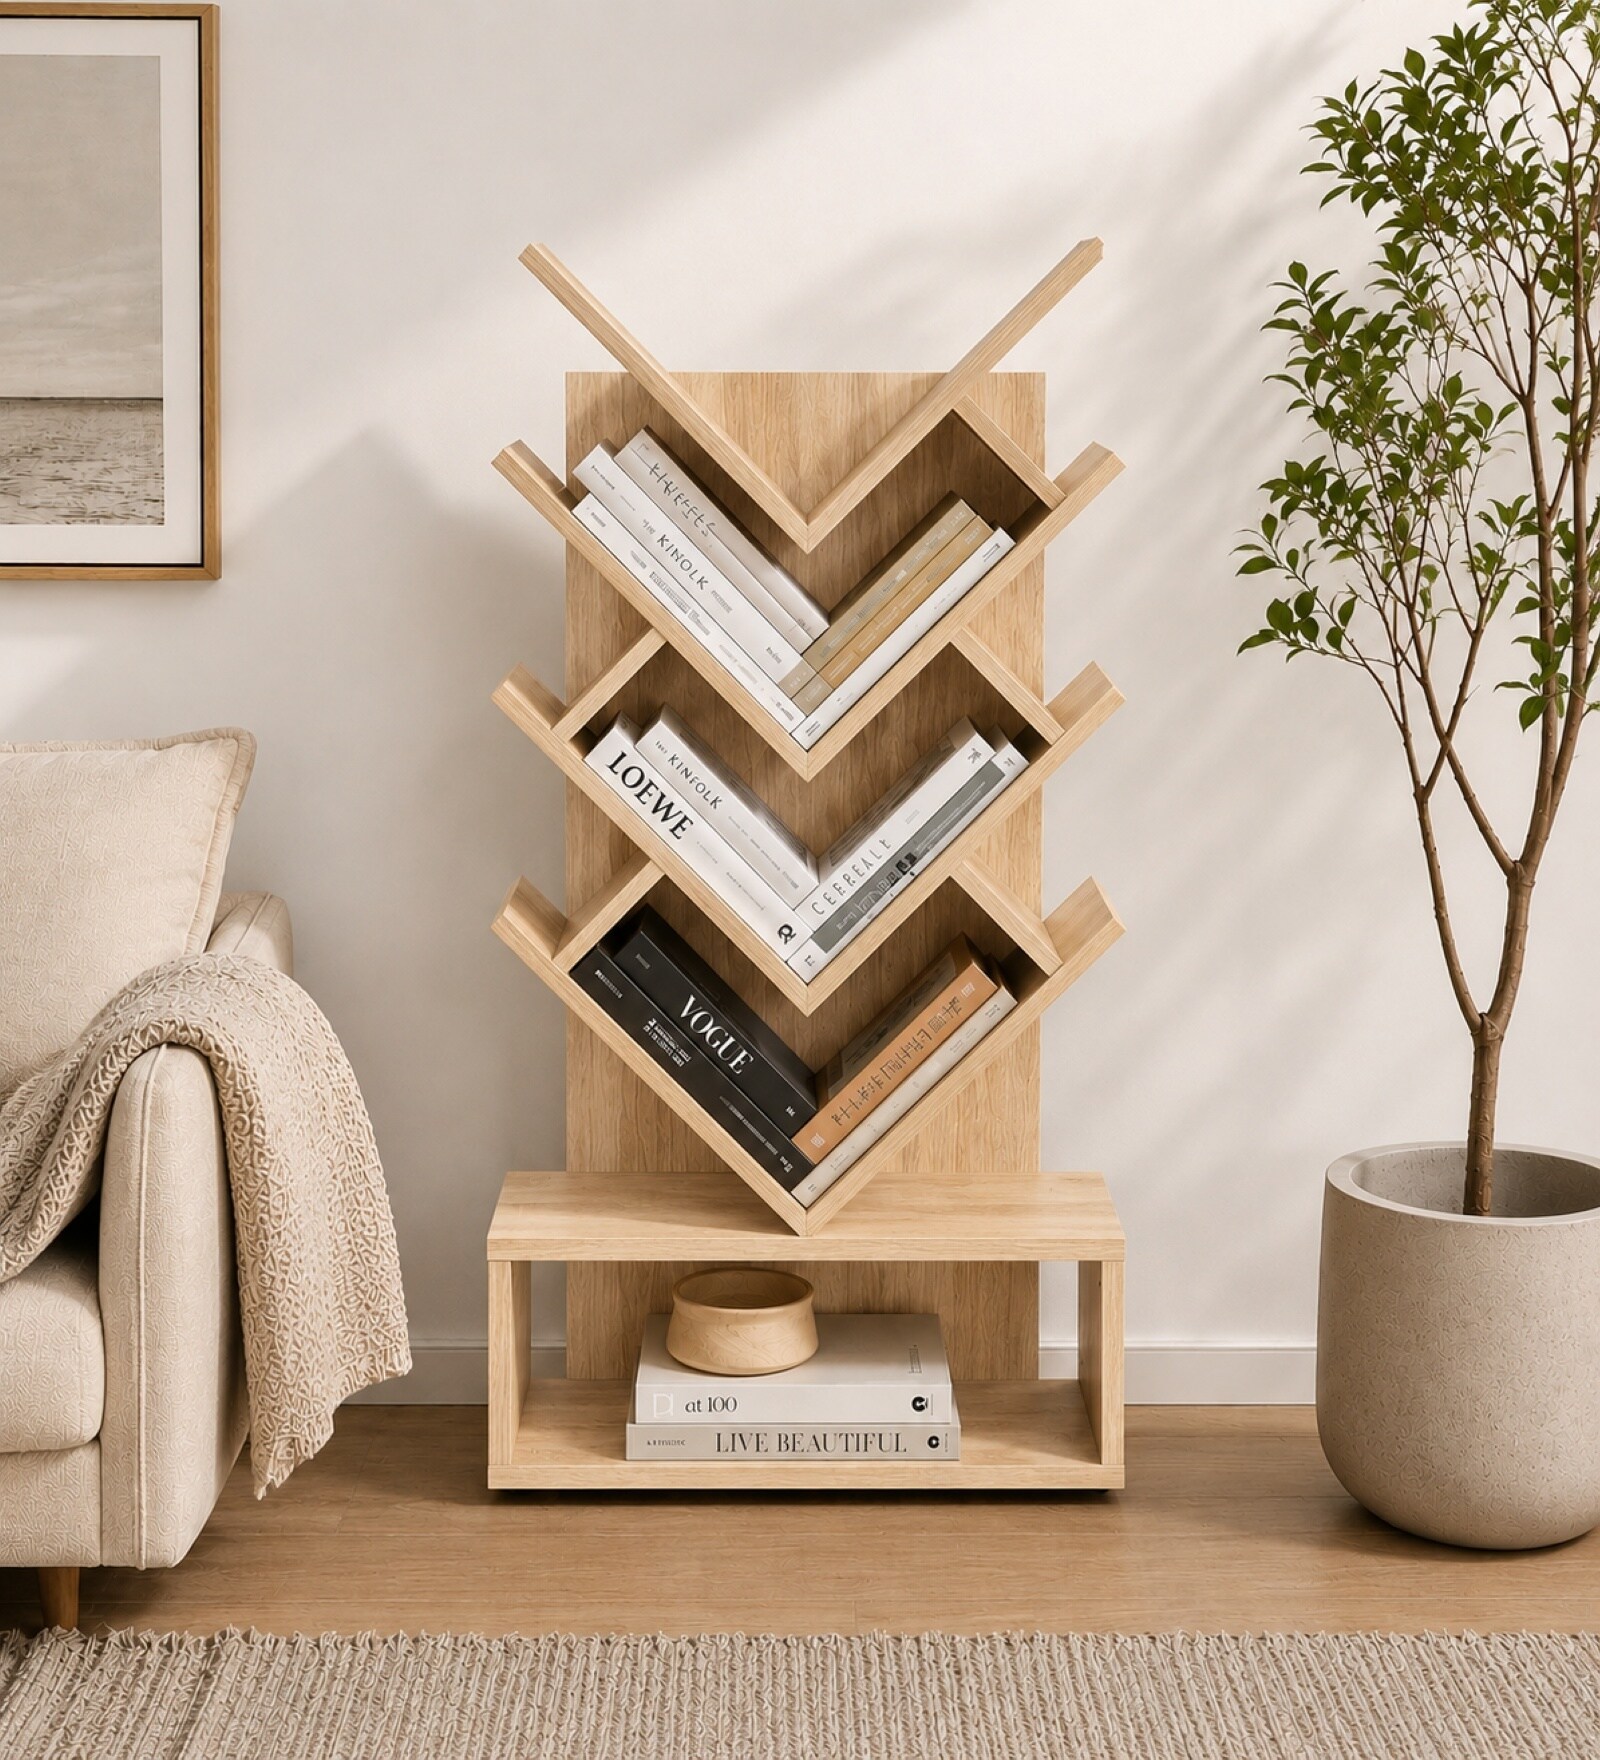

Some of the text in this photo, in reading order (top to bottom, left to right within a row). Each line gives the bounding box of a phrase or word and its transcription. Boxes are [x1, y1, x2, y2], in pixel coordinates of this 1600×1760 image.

[605, 751, 694, 840] LOEWE
[668, 754, 723, 810] KINFOLK
[680, 994, 754, 1075] VOGUE
[685, 1399, 702, 1413] at
[708, 1396, 737, 1413] 100
[716, 1432, 769, 1453] LIVE
[777, 1432, 907, 1453] BEAUTIFUL
